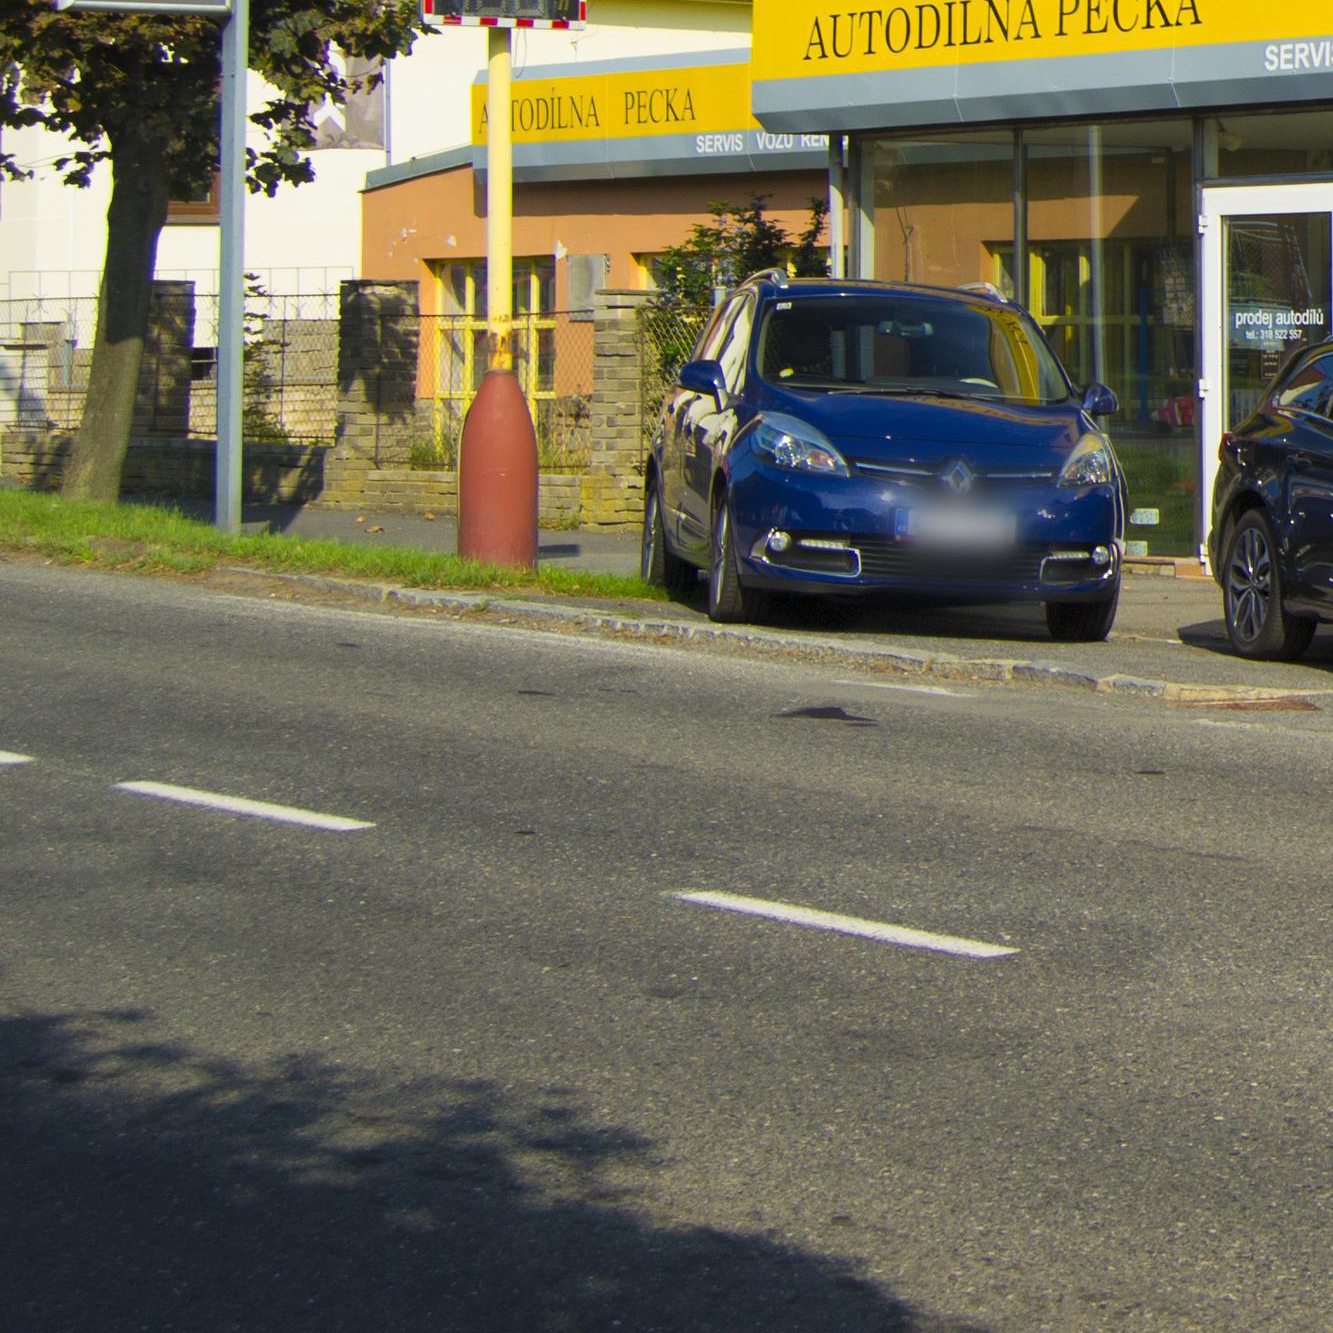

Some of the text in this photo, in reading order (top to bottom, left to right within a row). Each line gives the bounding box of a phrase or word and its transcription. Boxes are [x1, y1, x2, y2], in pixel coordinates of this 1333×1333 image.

[479, 87, 696, 134] ATODÍLNA PECKA
[696, 133, 743, 153] SERVIS
[1235, 308, 1324, 329] prodej autodílů
[1274, 329, 1288, 340] 522
[1289, 329, 1302, 340] 557
